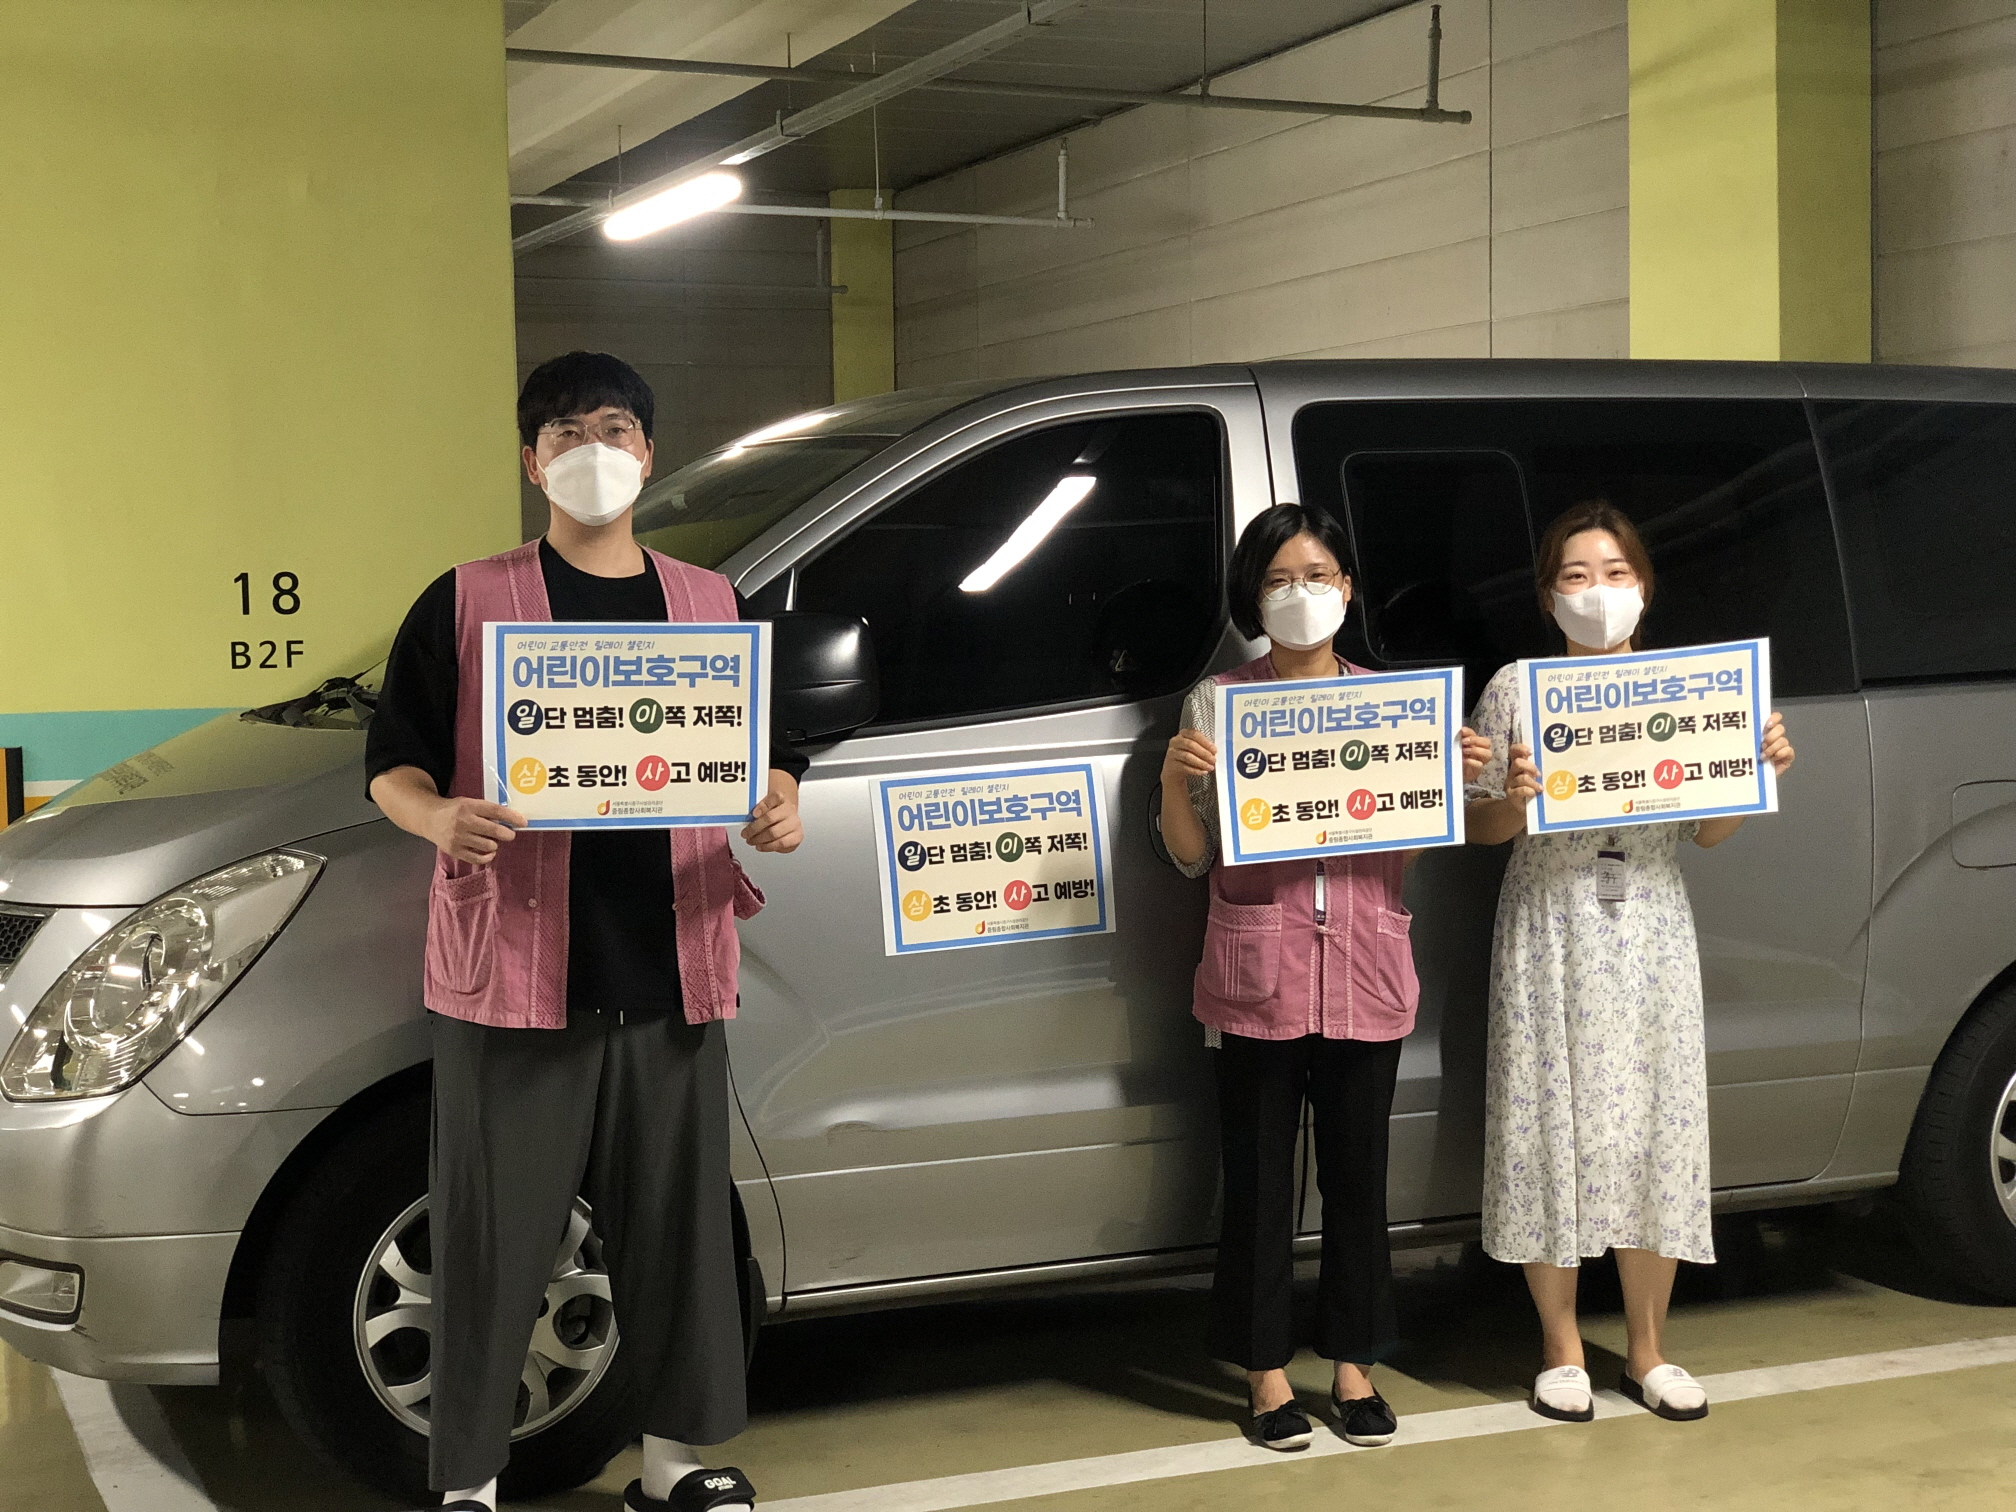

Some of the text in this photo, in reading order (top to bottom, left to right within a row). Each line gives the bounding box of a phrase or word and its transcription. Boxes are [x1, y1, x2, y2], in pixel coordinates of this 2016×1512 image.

[233, 571, 301, 615] 18
[230, 640, 304, 669] B2F
[517, 640, 547, 650] 어린이
[512, 654, 741, 688] 어린이보호구역
[1545, 667, 1743, 714] 어린이보호구역
[516, 704, 743, 730] 일단 멈춤! 이쪽 저쪽!
[1240, 696, 1436, 739] 어린이보호구역
[1549, 711, 1747, 748] 일단 멈춤! 이쪽 저쪽!
[517, 760, 747, 788] 삼초 동안! 사고 예방!
[1243, 741, 1438, 773] 일단 멈춤! 이쪽 저쪽!
[1552, 757, 1753, 795] 삼초 동안! 사고 예방!
[898, 789, 1082, 832] 어린이보호구역
[1247, 788, 1443, 824] 삼초 동안! 사고 예방!
[904, 832, 1088, 866] 일단 멈춤! 이쪽 저쪽!
[908, 879, 1095, 916] 삼초 동안! 사고 예방!
[704, 1476, 737, 1489] GOAL
